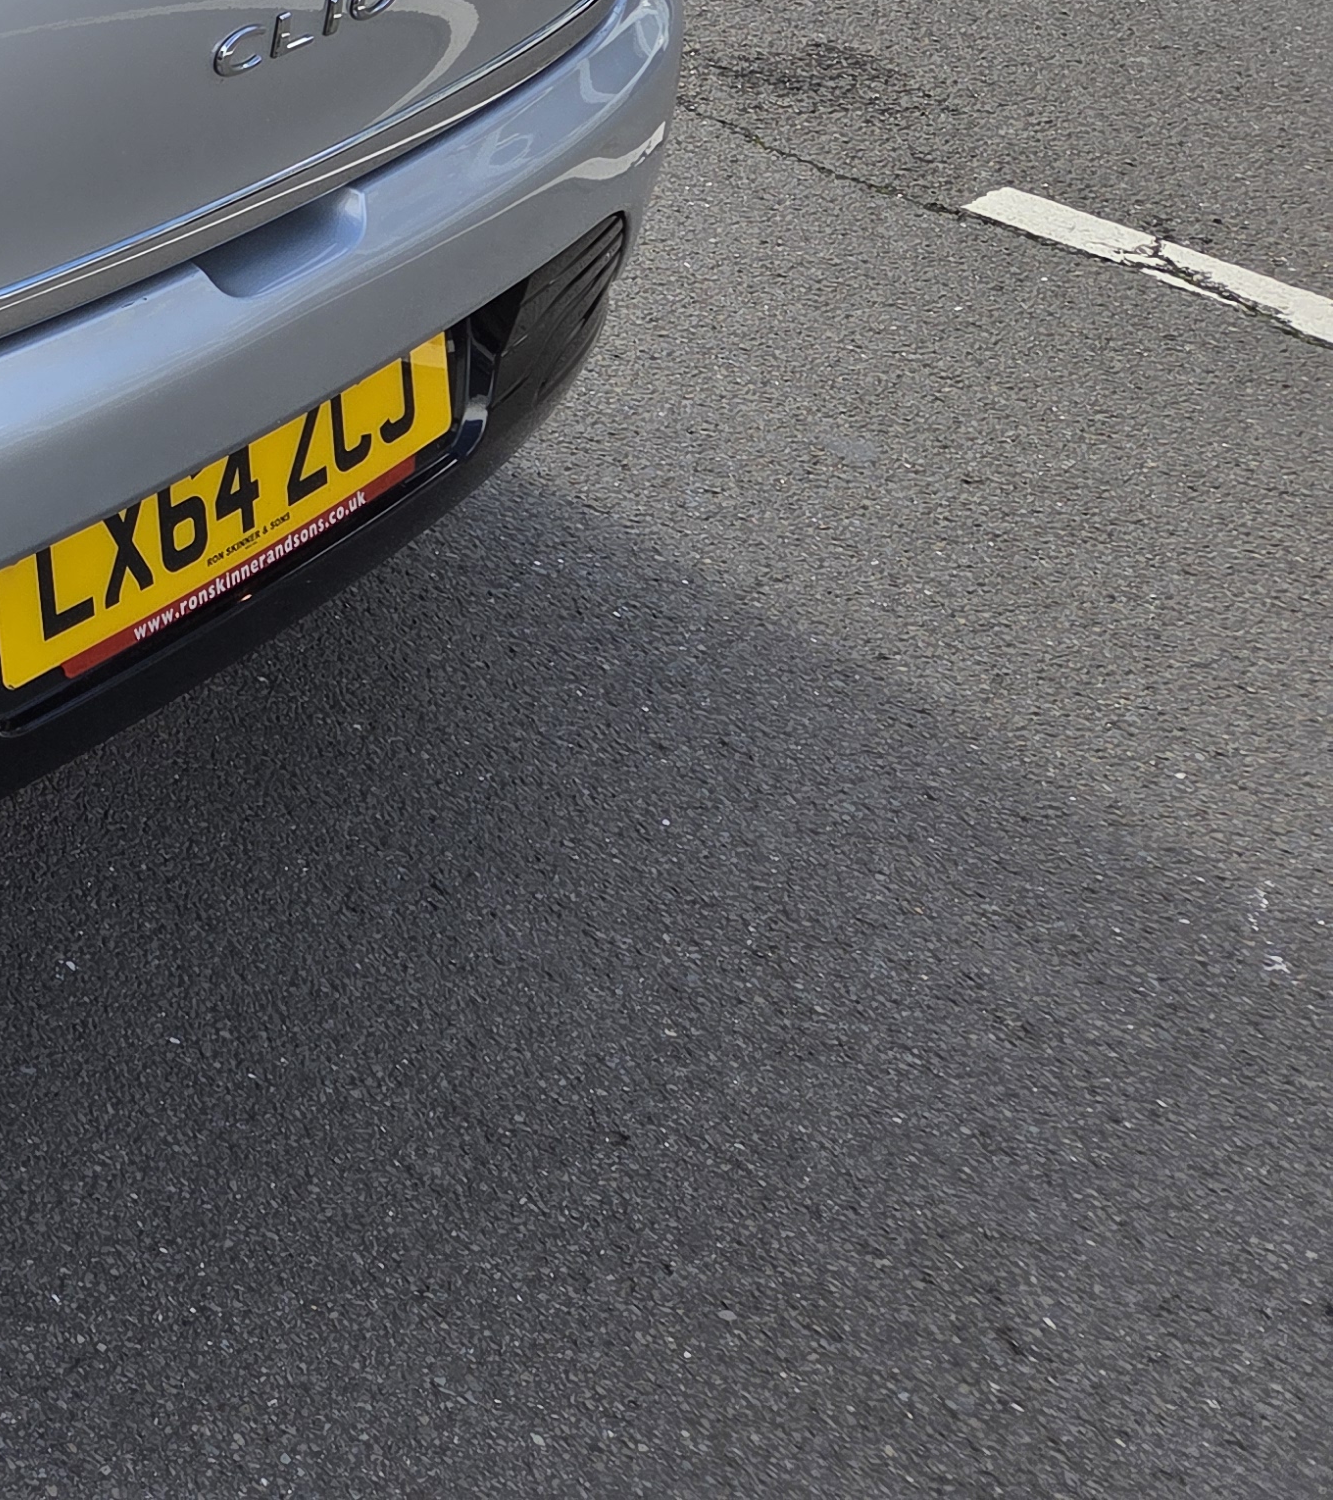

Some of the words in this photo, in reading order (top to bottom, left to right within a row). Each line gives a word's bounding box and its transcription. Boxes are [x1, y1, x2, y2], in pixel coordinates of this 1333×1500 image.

[35, 445, 259, 642] LX64
[287, 358, 416, 507] ZCJ
[133, 490, 367, 641] www.ronskinnerandsons.co.uk
[207, 551, 224, 567] RON
[226, 530, 260, 557] SKINNER
[262, 525, 268, 535] &
[270, 512, 291, 530] SONS
